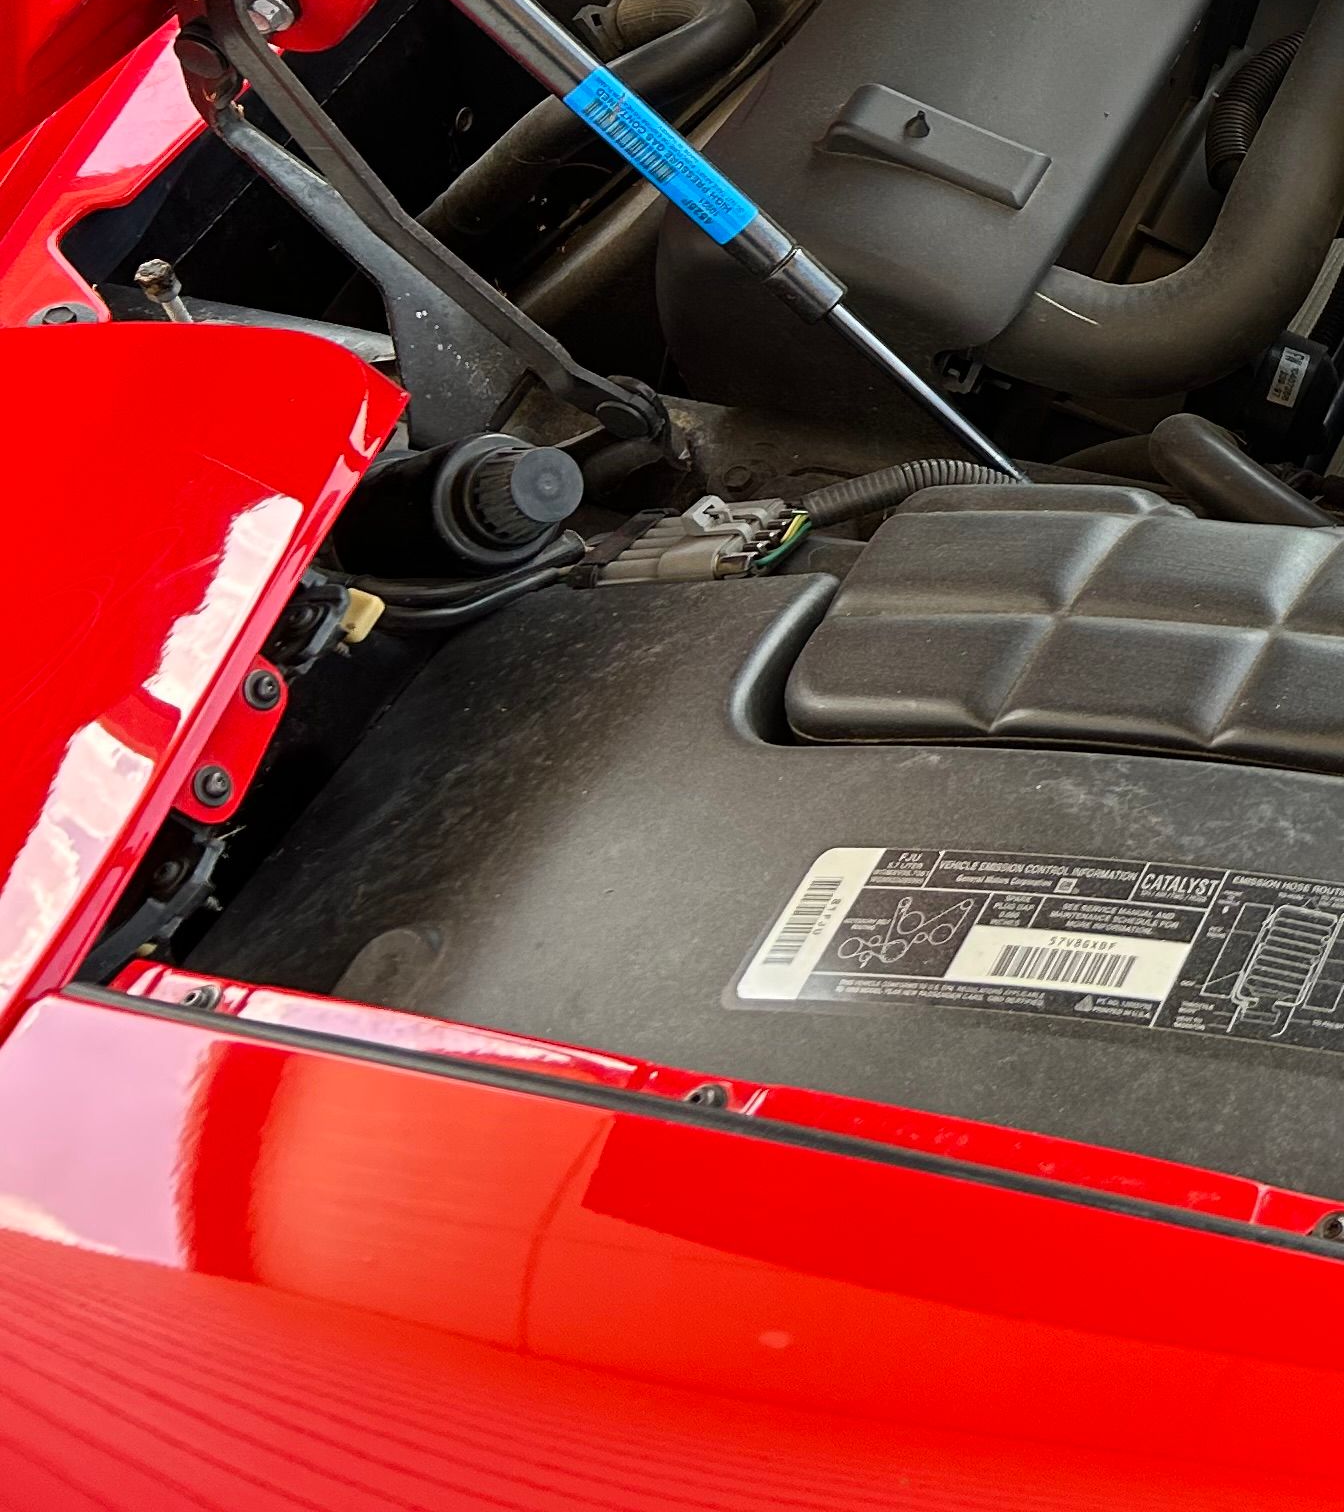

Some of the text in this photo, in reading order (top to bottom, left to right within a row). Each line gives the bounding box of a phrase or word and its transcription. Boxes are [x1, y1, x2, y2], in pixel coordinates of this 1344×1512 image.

[644, 132, 665, 152] GAS
[663, 149, 711, 193] PRESSURE
[708, 190, 732, 213] HIGH
[898, 852, 920, 863] FJU
[939, 860, 1139, 882] VEHICLE EMISSION CONTROL INFORMATION
[1141, 874, 1221, 895] CATALYST
[1232, 875, 1282, 890] EMISSION
[1284, 880, 1310, 893] HOSE
[1049, 910, 1111, 923] MAINTENANCE
[1111, 914, 1158, 927] SCHEDULE
[1080, 904, 1118, 914] SERVICE
[1119, 906, 1156, 917] MANUAL
[1157, 911, 1176, 920] AND
